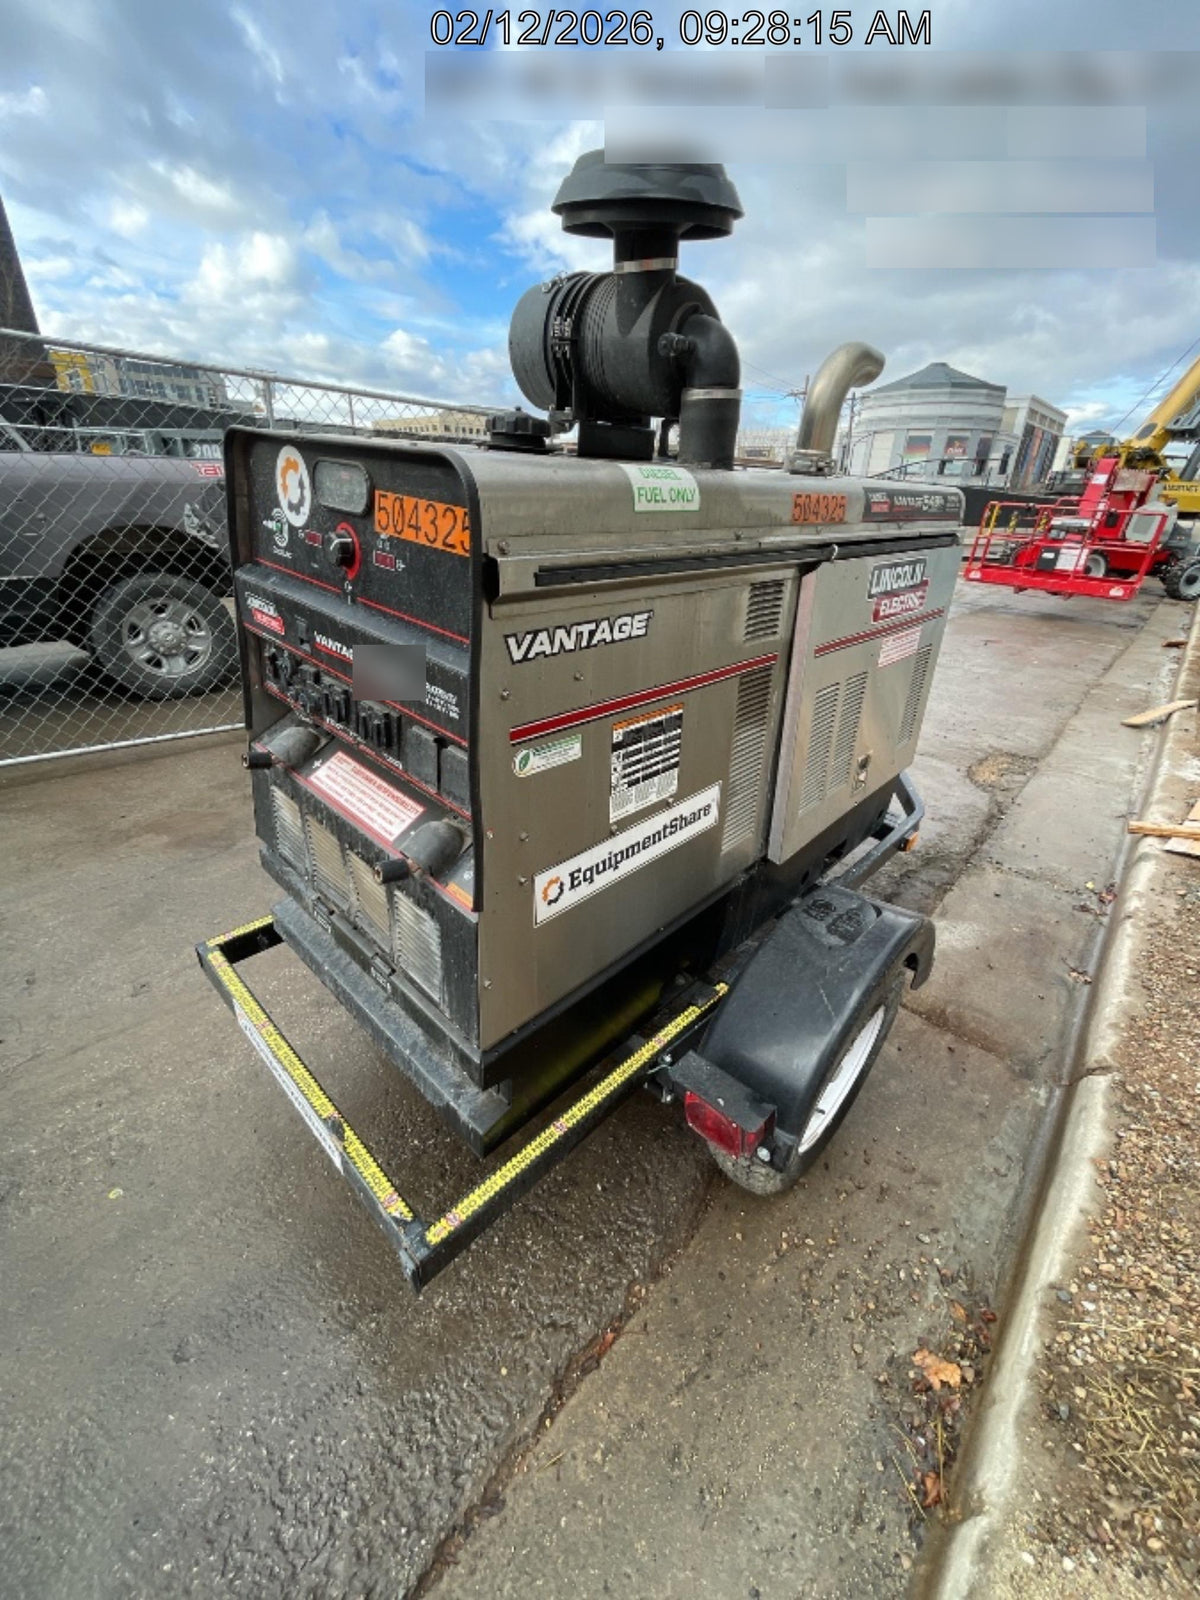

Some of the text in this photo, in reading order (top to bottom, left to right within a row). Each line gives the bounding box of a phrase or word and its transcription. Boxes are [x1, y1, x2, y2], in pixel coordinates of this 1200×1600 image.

[637, 486, 696, 503] FUEL ONLY
[793, 494, 846, 522] 504325
[377, 493, 470, 552] 504325
[871, 563, 924, 594] LINCOLN
[314, 630, 353, 660] VANTAG
[504, 610, 654, 664] VANTAGE
[568, 803, 711, 890] EquipmentShare
[458, 1130, 556, 1215] DO NOT STAND HERE
